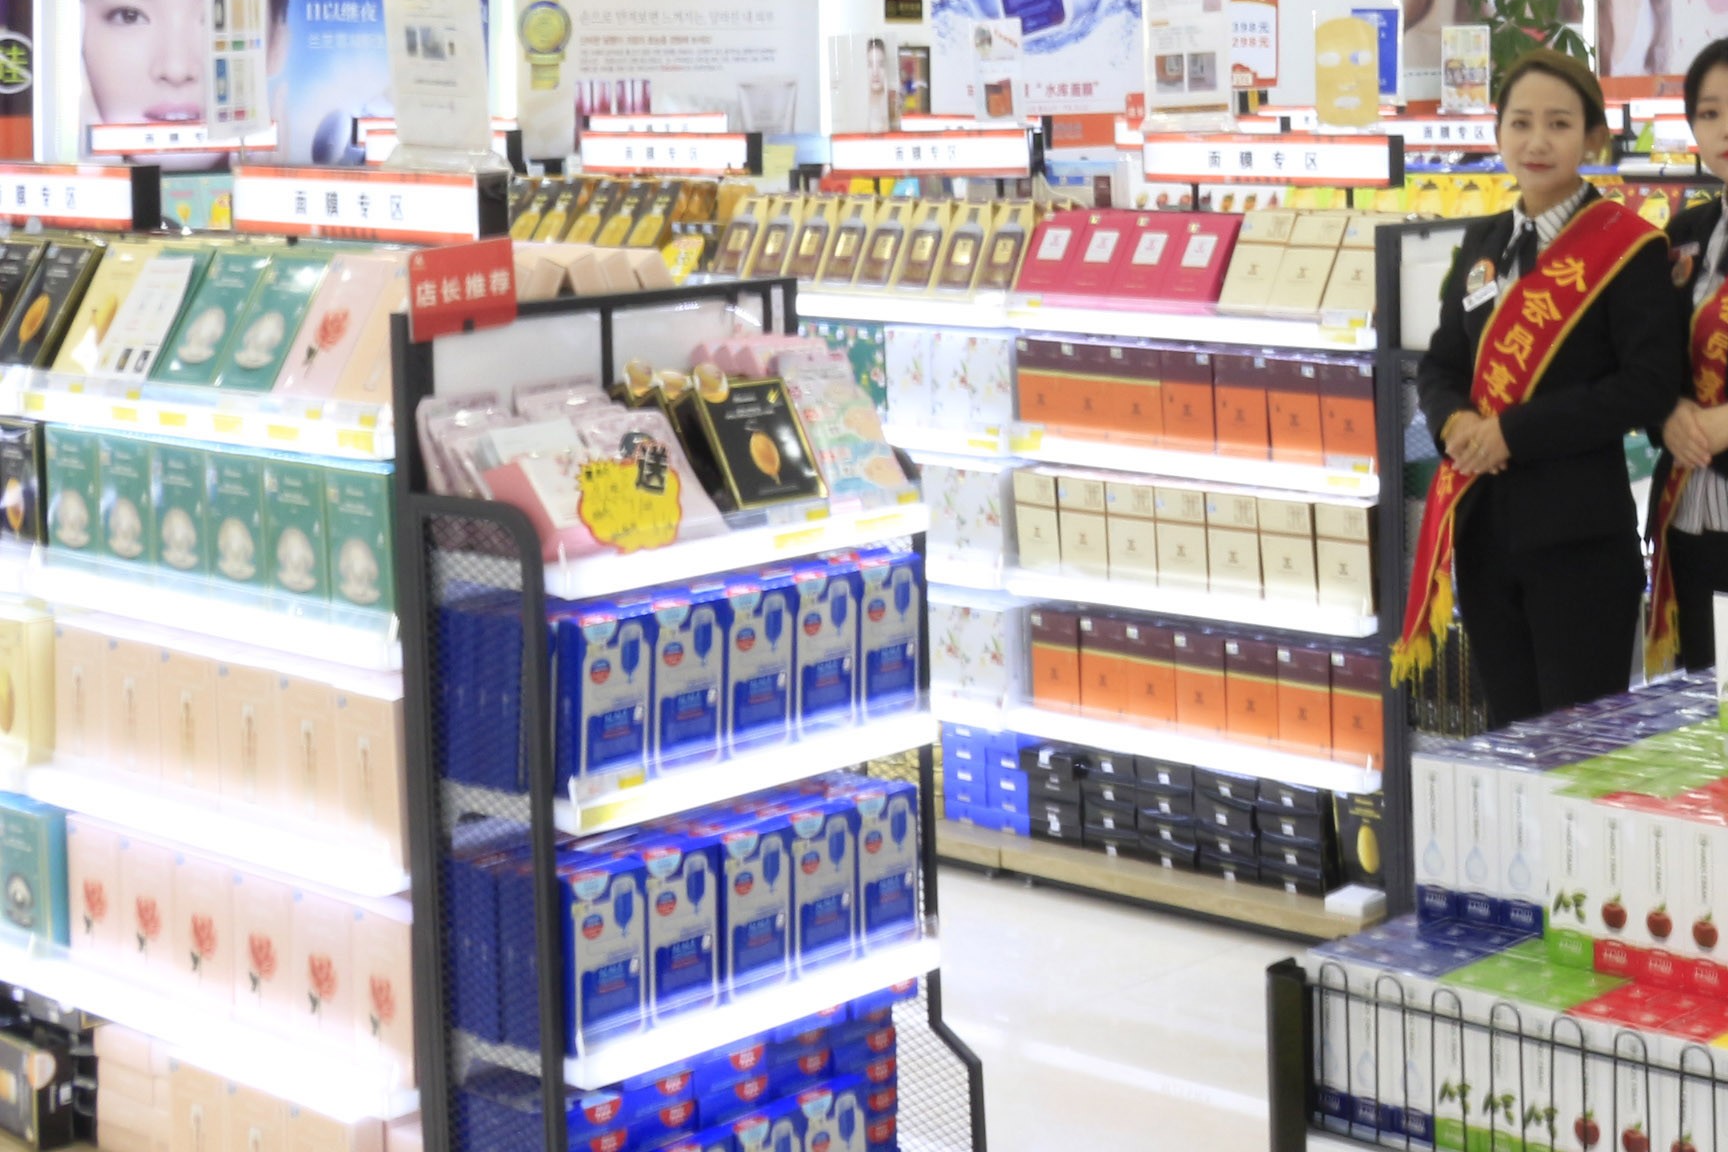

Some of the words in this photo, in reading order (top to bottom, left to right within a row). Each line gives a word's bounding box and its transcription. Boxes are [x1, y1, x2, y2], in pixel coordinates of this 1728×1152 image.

[1208, 151, 1319, 170] 面膜专区
[294, 190, 404, 222] 面膜专区
[415, 268, 512, 310] 店长推荐
